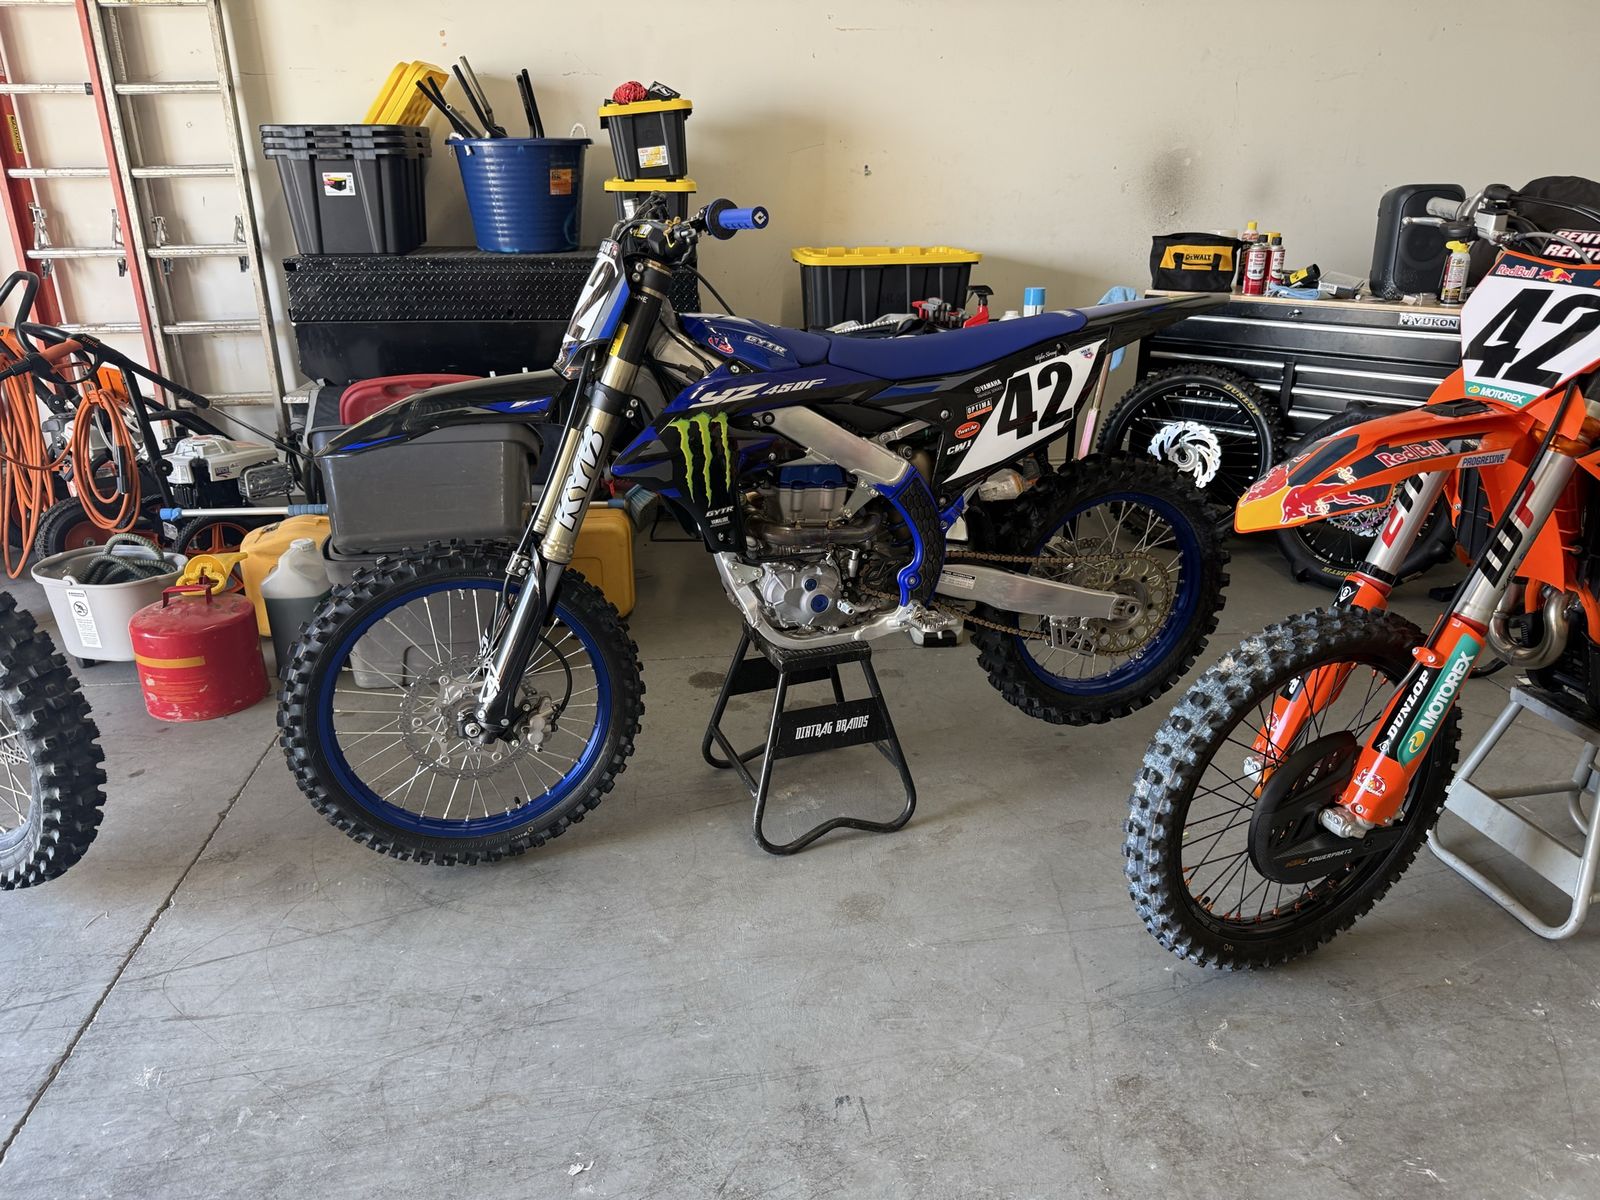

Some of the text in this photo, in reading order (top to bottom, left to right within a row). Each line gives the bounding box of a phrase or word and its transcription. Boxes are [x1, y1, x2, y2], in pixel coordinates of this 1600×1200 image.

[1542, 244, 1600, 261] RENT
[1414, 317, 1457, 328] YUKON
[745, 335, 788, 353] GYTR
[1463, 288, 1600, 389] 42
[688, 378, 827, 410] YZ 450F
[980, 379, 1002, 391] YAMAHA
[997, 361, 1073, 440] 42
[1224, 384, 1260, 416] DUNLOP
[1479, 386, 1526, 404] MOTOREX
[967, 400, 992, 414] OPTIMA
[1462, 454, 1505, 466] PROGRESSIVE
[554, 424, 604, 532] KYB
[705, 505, 735, 518] GYTR
[1418, 650, 1475, 730] MOTOREX
[1386, 669, 1430, 741] DUNLOP
[795, 715, 870, 740] DIRTBAG BRANDS
[1307, 848, 1353, 863] POWERPARTS
